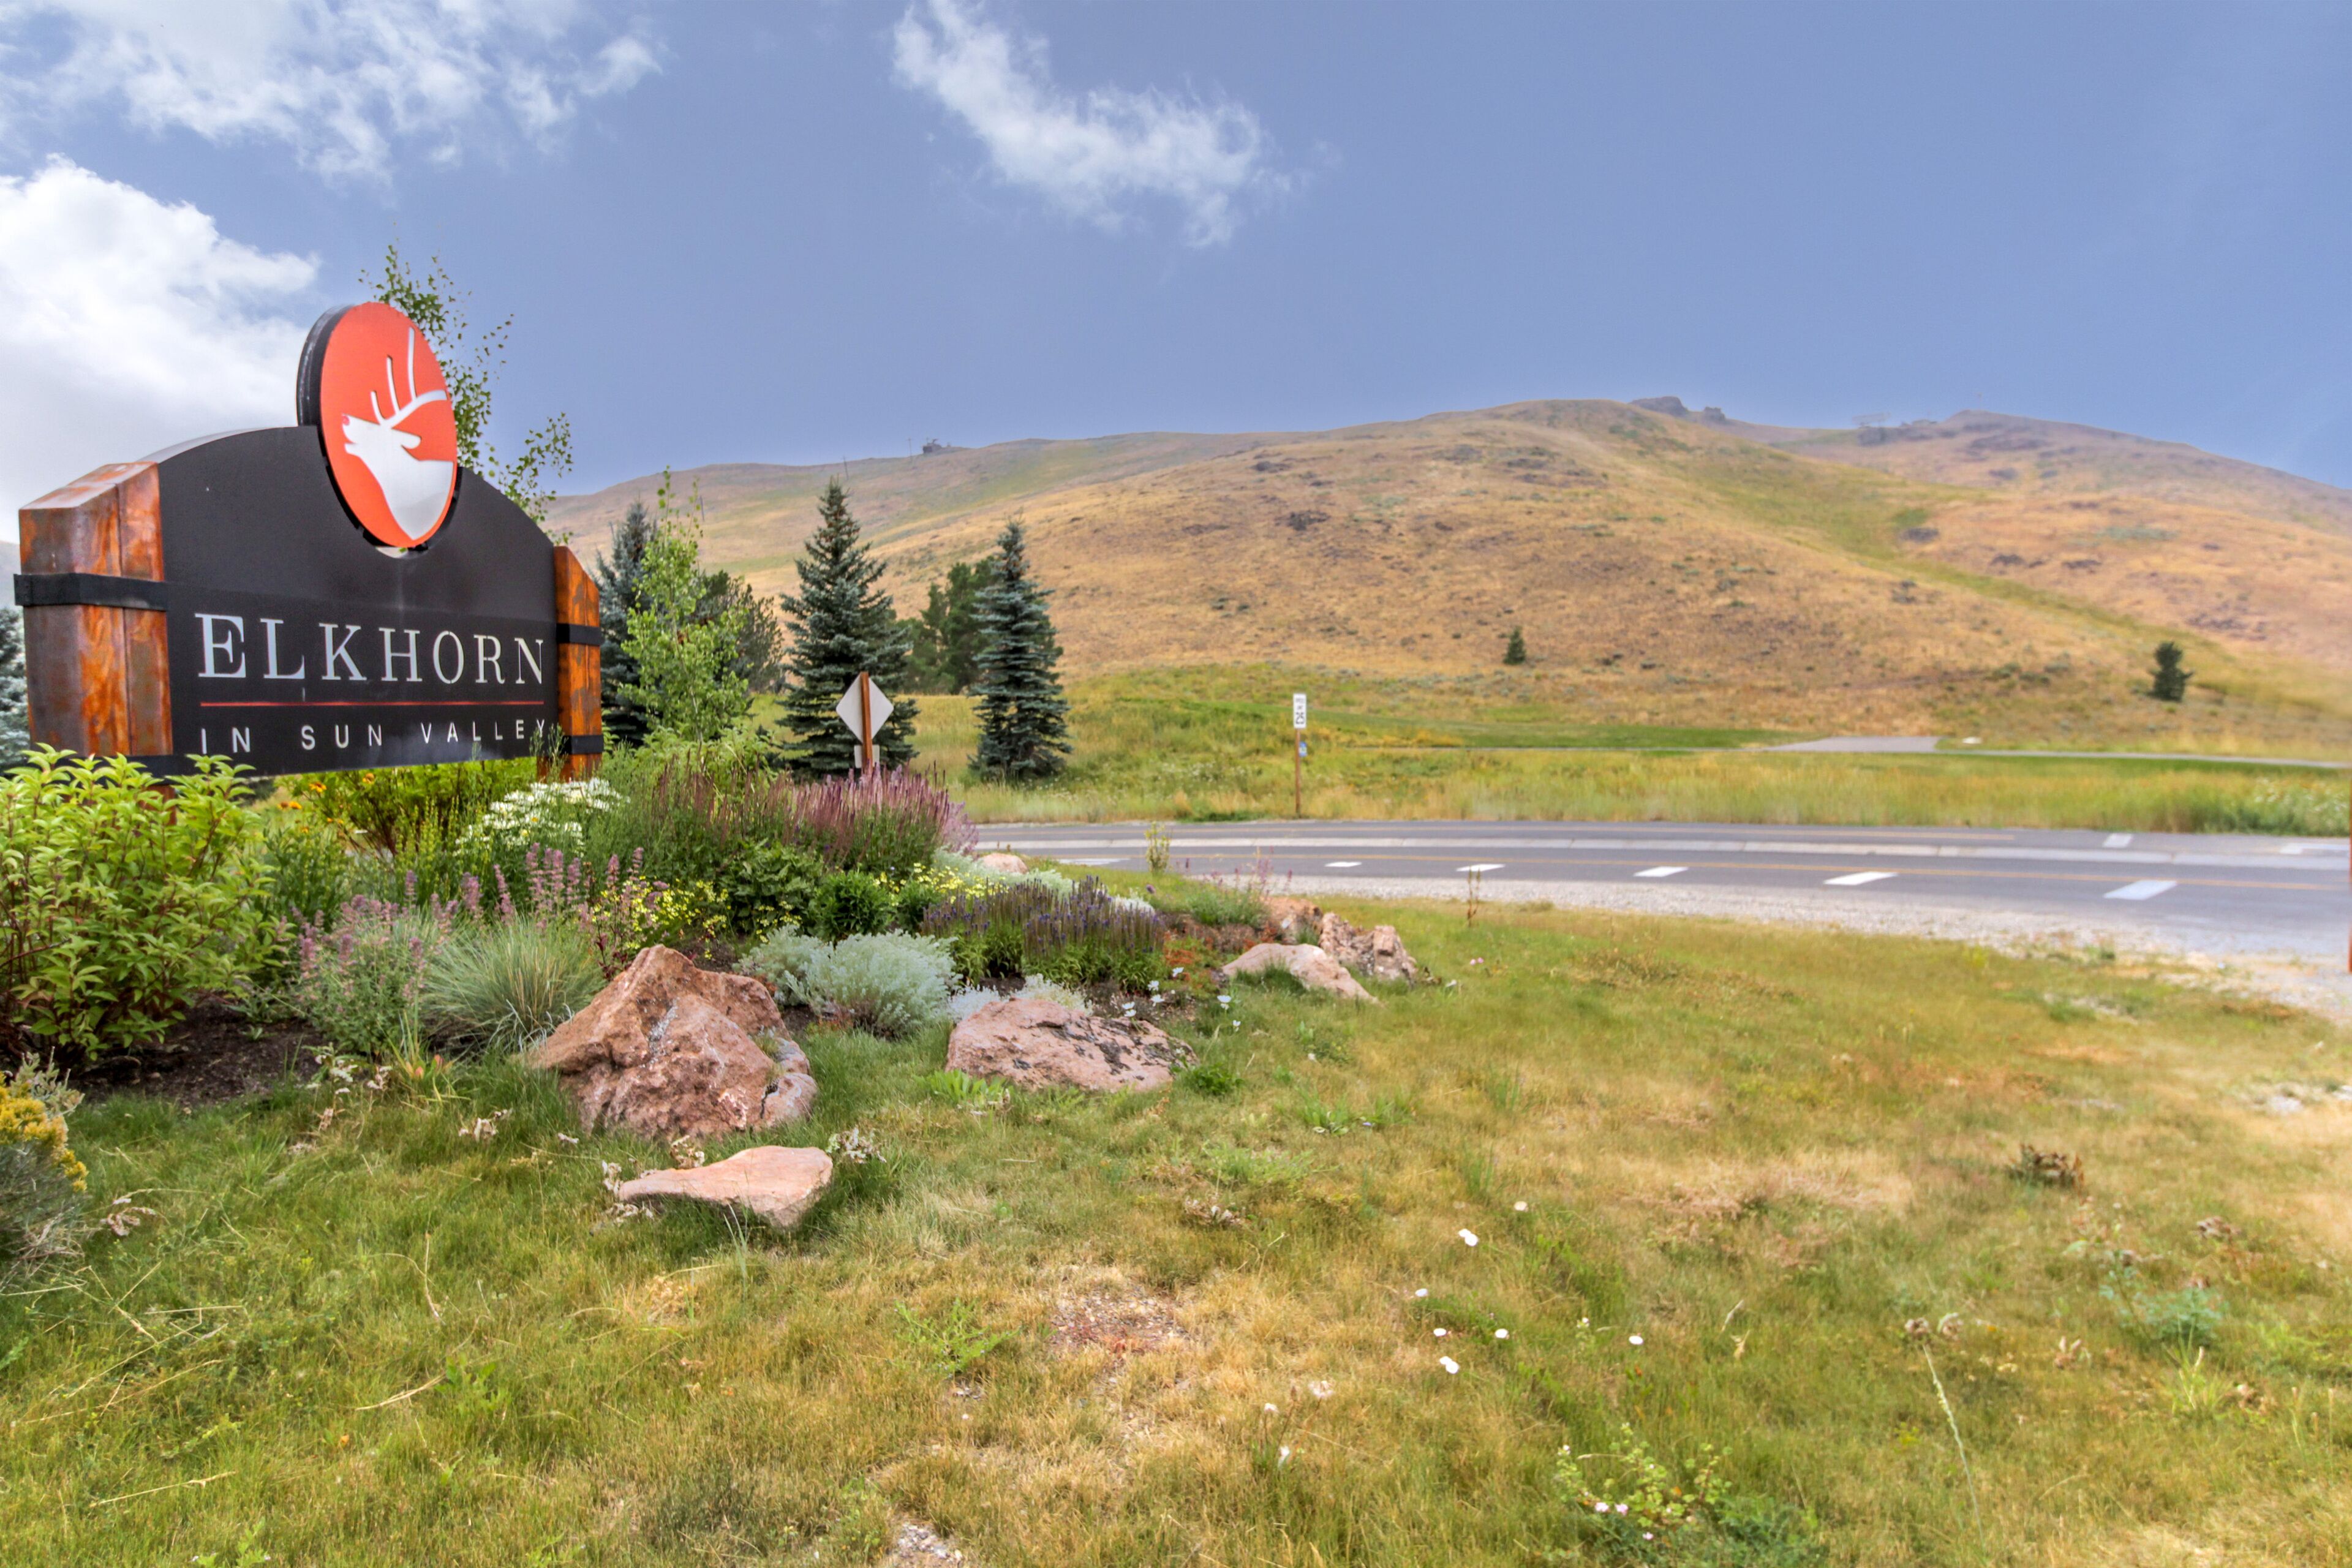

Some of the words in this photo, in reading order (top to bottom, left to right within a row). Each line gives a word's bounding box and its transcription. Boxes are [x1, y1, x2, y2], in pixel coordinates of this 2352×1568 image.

[195, 613, 543, 684] ELKHORN
[201, 726, 251, 754] IN
[301, 724, 382, 750] SUN
[420, 718, 545, 744] VALLEY
[1295, 712, 1305, 724] 25
